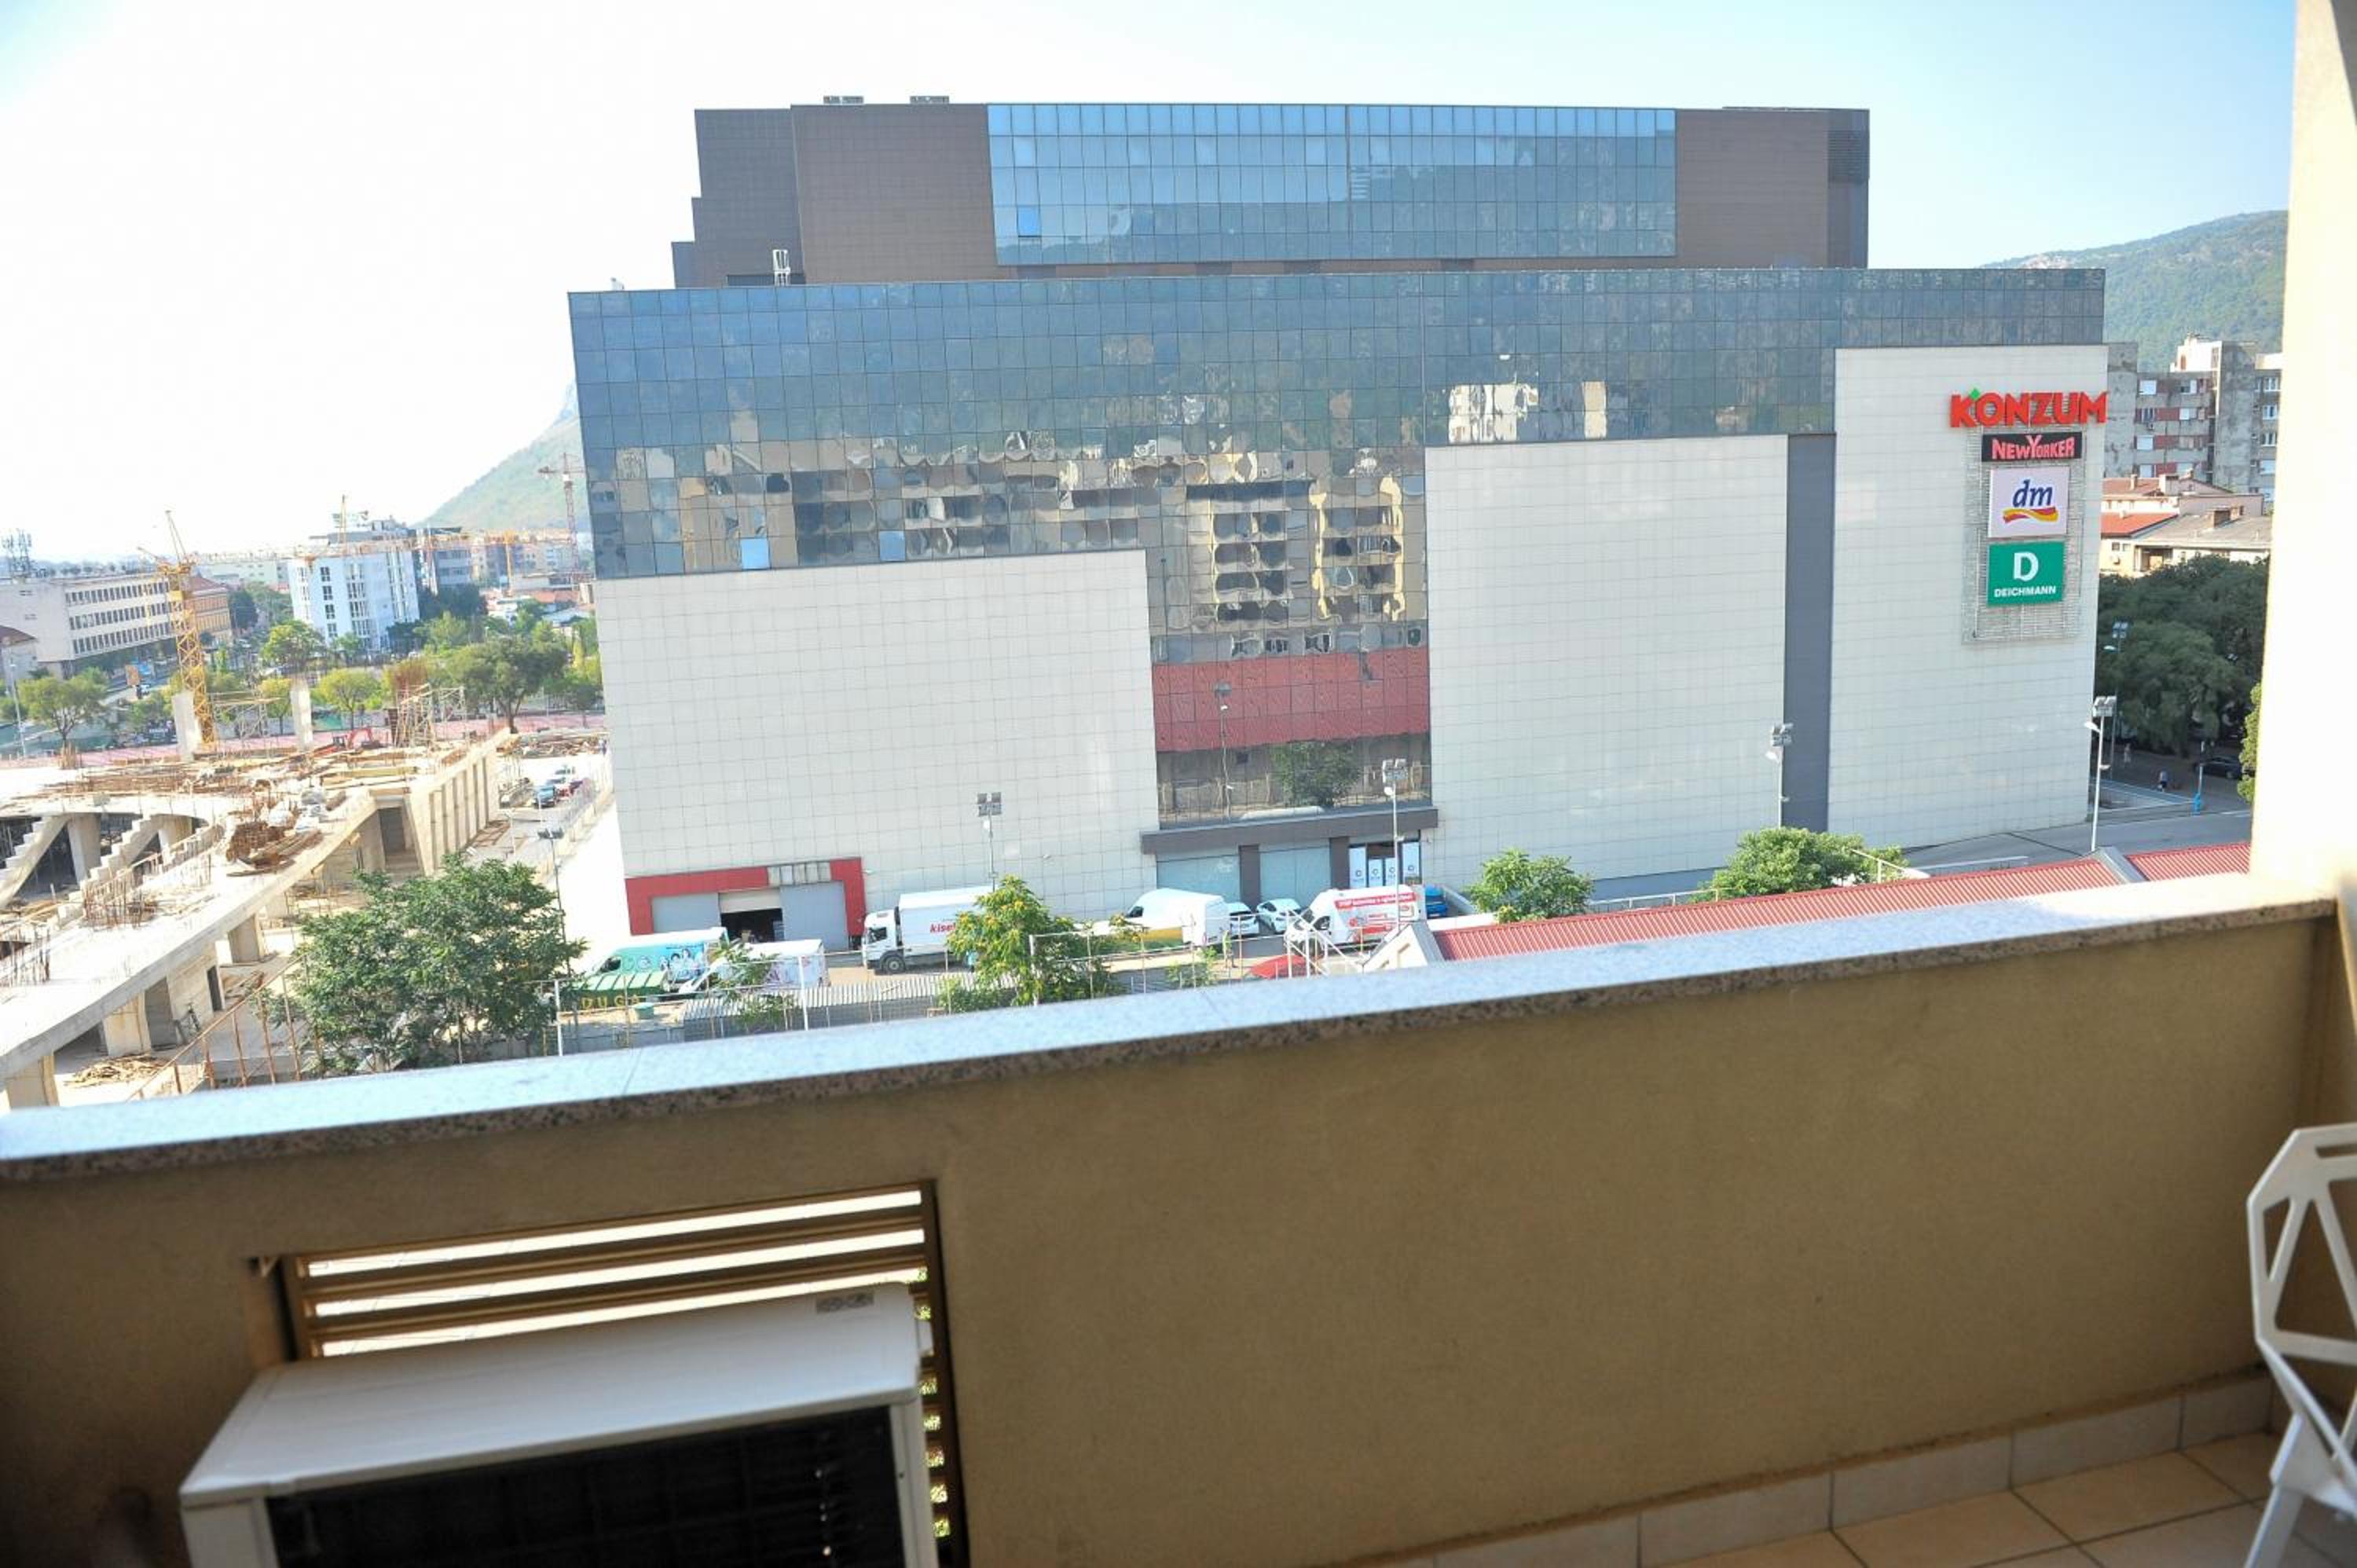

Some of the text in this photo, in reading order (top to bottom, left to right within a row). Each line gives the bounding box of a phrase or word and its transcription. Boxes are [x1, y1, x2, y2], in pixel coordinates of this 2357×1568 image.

[1950, 391, 2108, 427] KONZUM
[2012, 478, 2053, 507] dm
[2014, 551, 2039, 581] D
[1994, 586, 2057, 598] DEICHMANN
